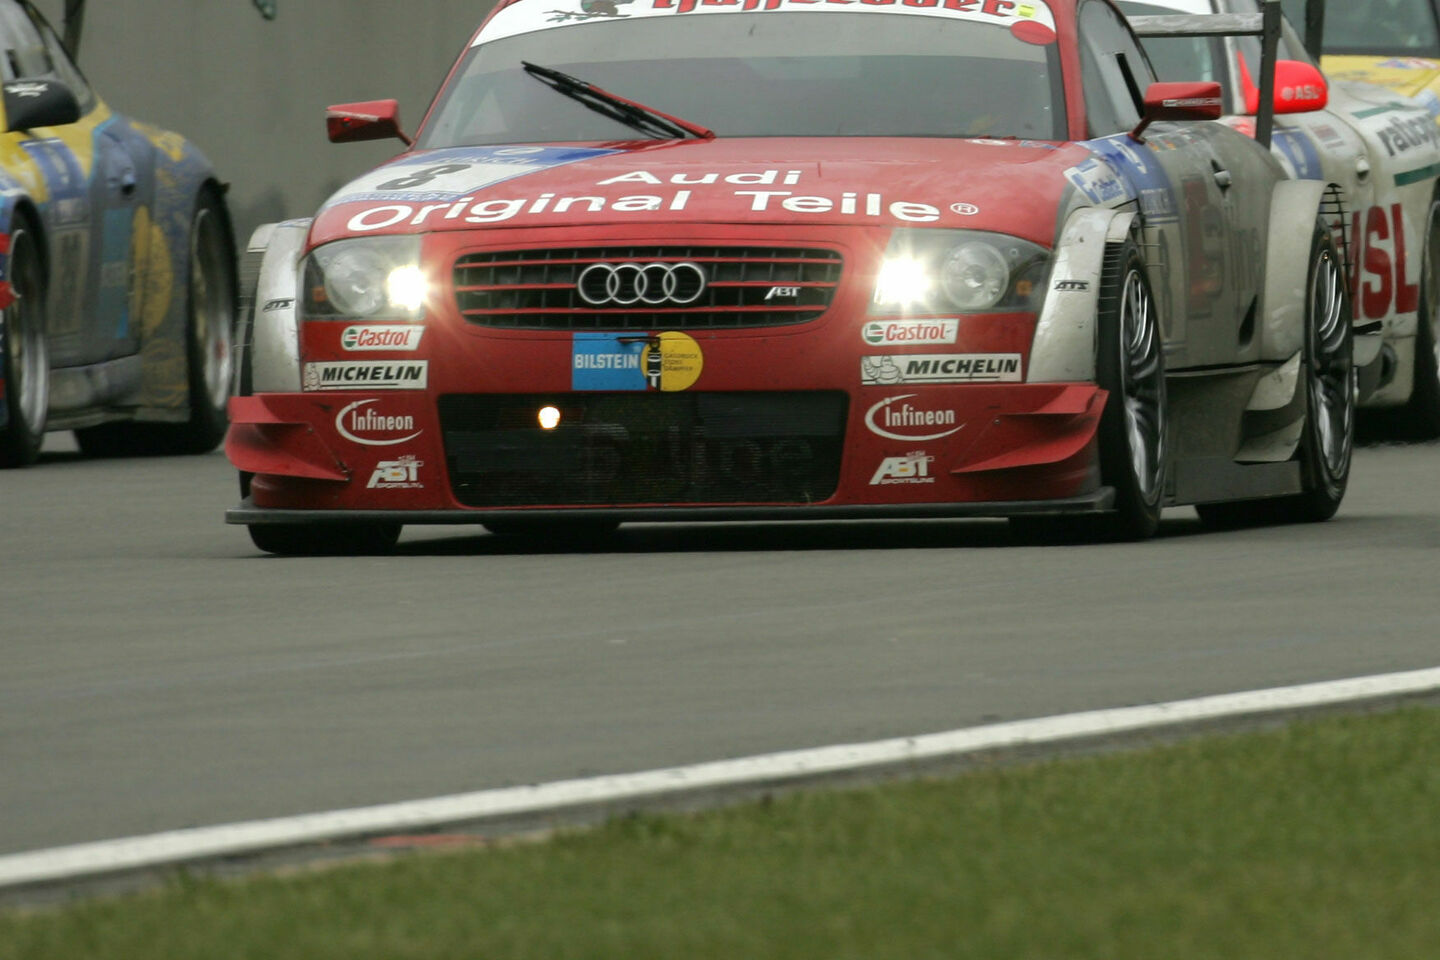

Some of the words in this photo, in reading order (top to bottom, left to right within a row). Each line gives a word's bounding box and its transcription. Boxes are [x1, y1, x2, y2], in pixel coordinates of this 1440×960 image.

[374, 163, 473, 191] 8
[596, 170, 803, 186] Audi
[346, 189, 692, 232] Original
[734, 190, 942, 223] Teile
[764, 286, 802, 300] ABT
[357, 328, 412, 347] Castrol
[885, 323, 947, 342] Castrol
[574, 353, 639, 369] BILSTEIN
[906, 358, 1019, 376] MICHELIN
[321, 365, 424, 382] MICHELIN
[351, 408, 414, 432] Infineon
[884, 403, 956, 427] Infineon
[366, 460, 424, 489] ABT
[869, 455, 935, 486] ABT
